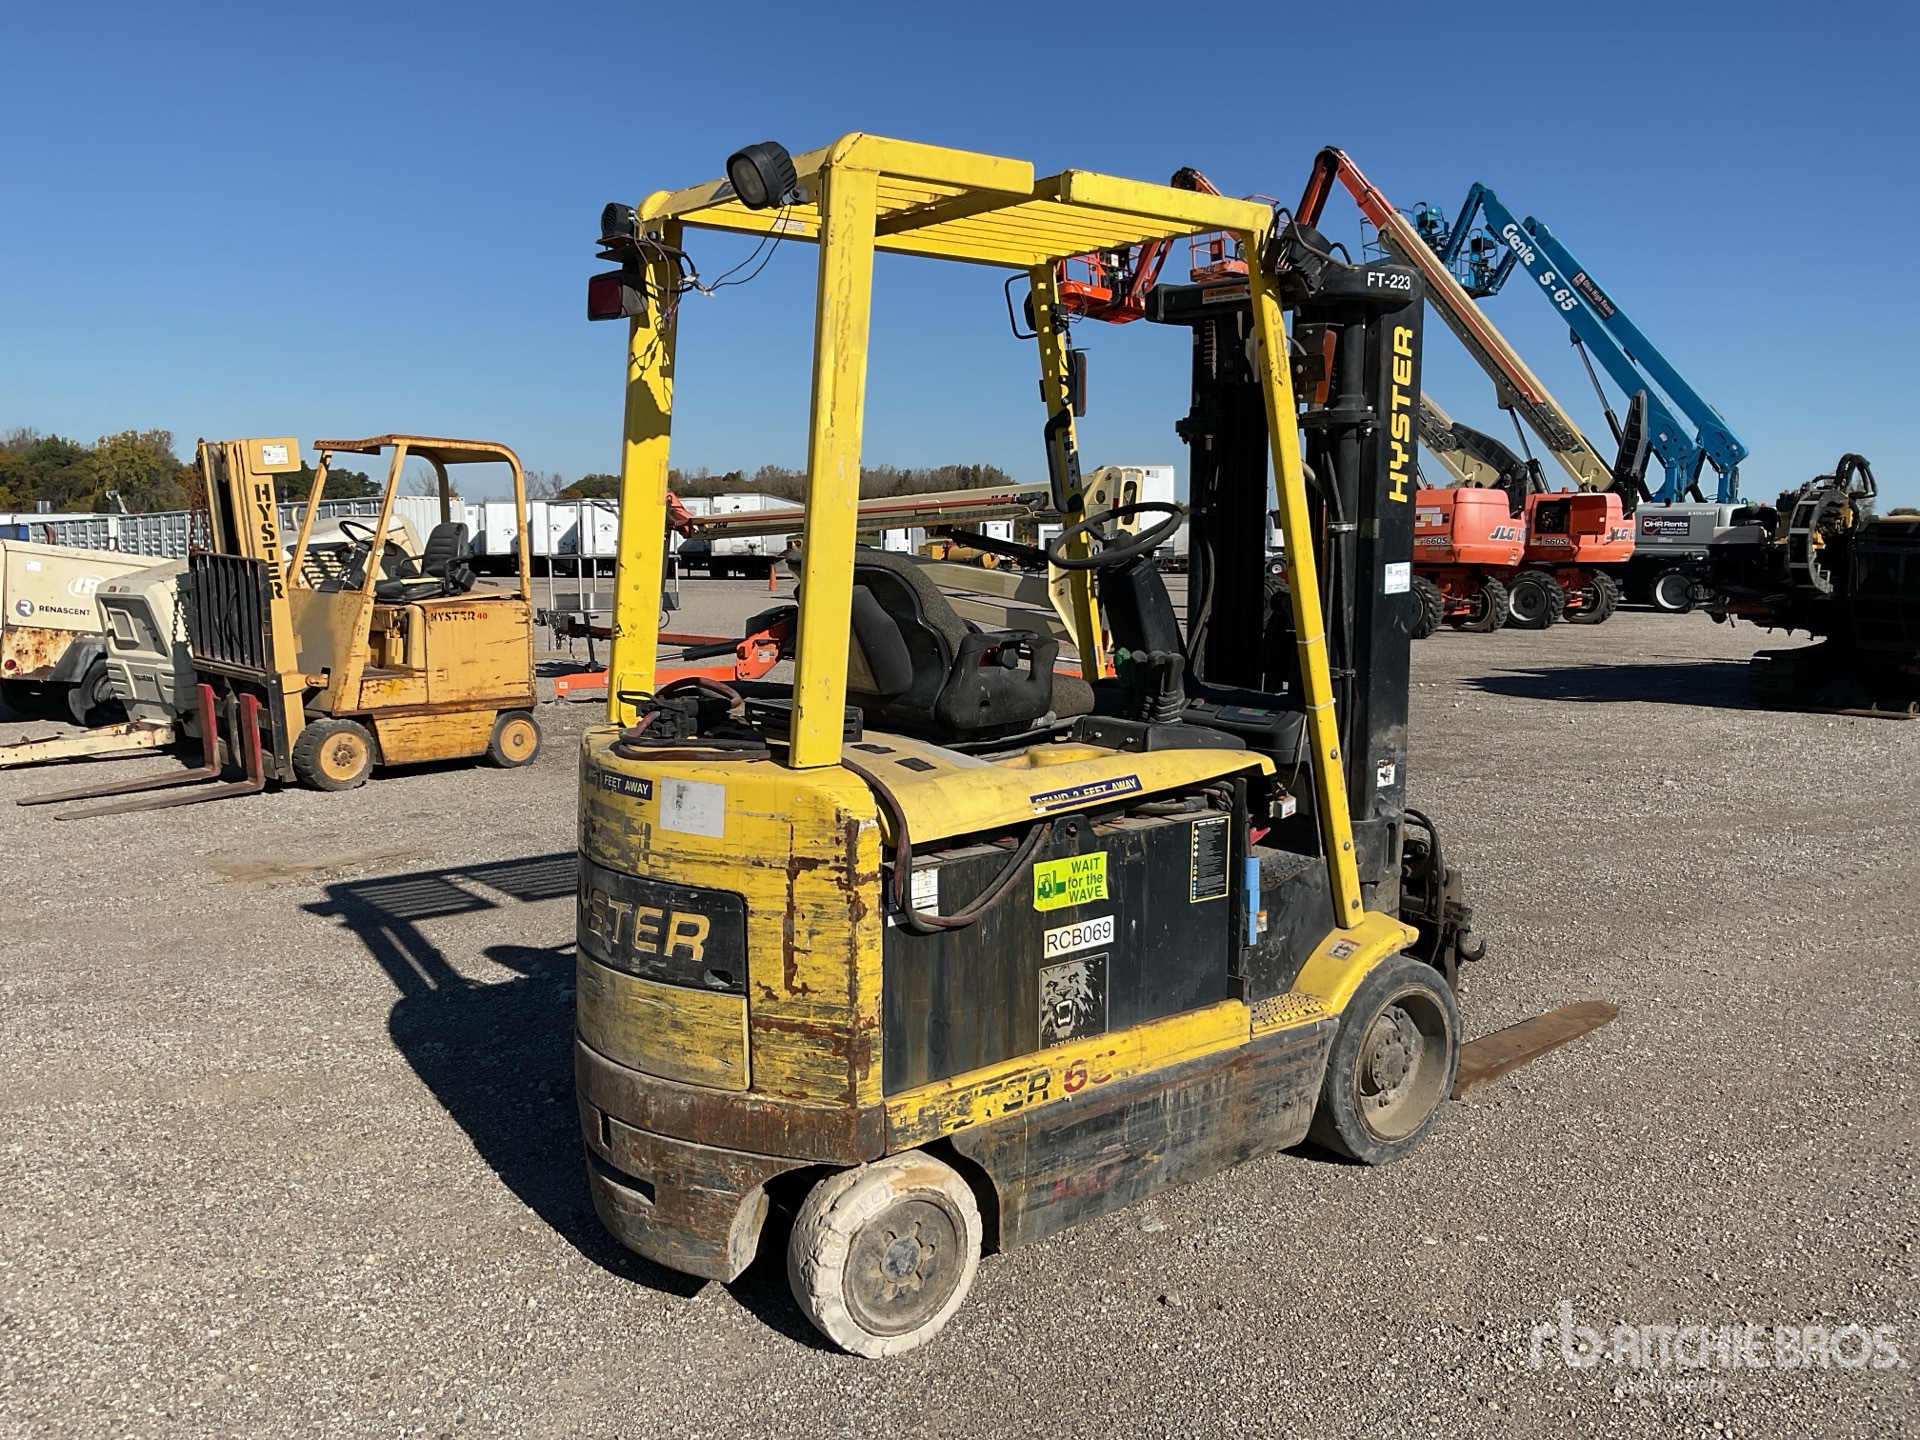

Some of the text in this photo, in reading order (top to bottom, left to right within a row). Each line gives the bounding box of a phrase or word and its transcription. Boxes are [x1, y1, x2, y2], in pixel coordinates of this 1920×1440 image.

[1502, 223, 1536, 266] Genie
[1367, 271, 1411, 291] FT-223
[1389, 326, 1413, 503] HYSTER
[254, 483, 285, 600] HYSTER
[1489, 526, 1516, 540] JLG
[39, 605, 91, 616] RENASCENT
[430, 611, 488, 622] HYSTER 40
[604, 774, 622, 789] FEET
[624, 780, 649, 795] AWAY
[1111, 778, 1137, 790] AWAY
[1071, 857, 1101, 874] WAIT
[1068, 873, 1103, 890] for the
[1068, 885, 1104, 903] WAVE
[1046, 920, 1112, 953] RCB069
